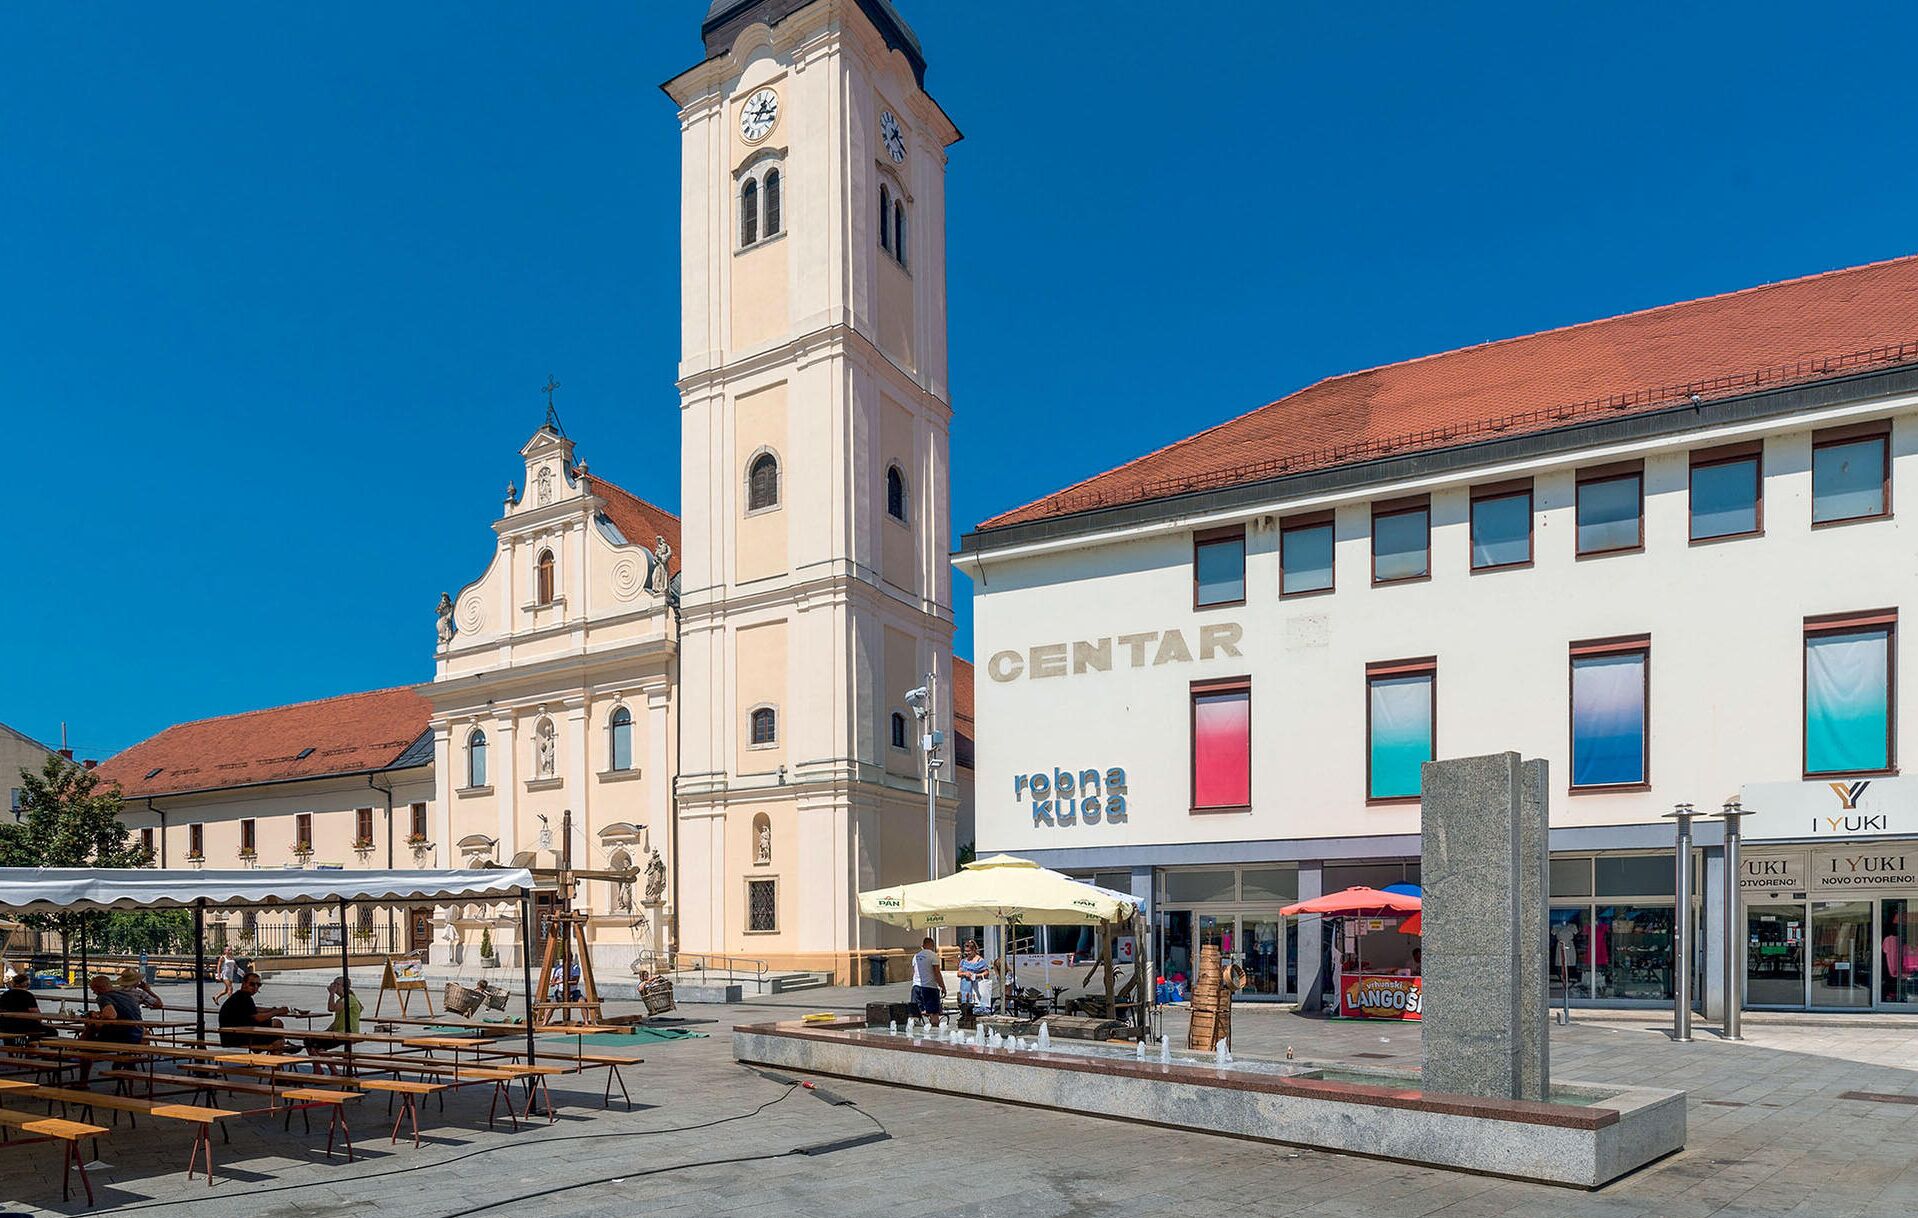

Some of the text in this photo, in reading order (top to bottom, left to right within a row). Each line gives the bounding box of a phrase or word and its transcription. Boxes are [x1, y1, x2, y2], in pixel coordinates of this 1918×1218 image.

[988, 622, 1243, 682] CENTAR
[1015, 767, 1127, 802] robna
[1813, 815, 1887, 832] I YUKI
[1832, 855, 1905, 872] I YUKI
[1822, 875, 1915, 885] NOVO OTVORENO!
